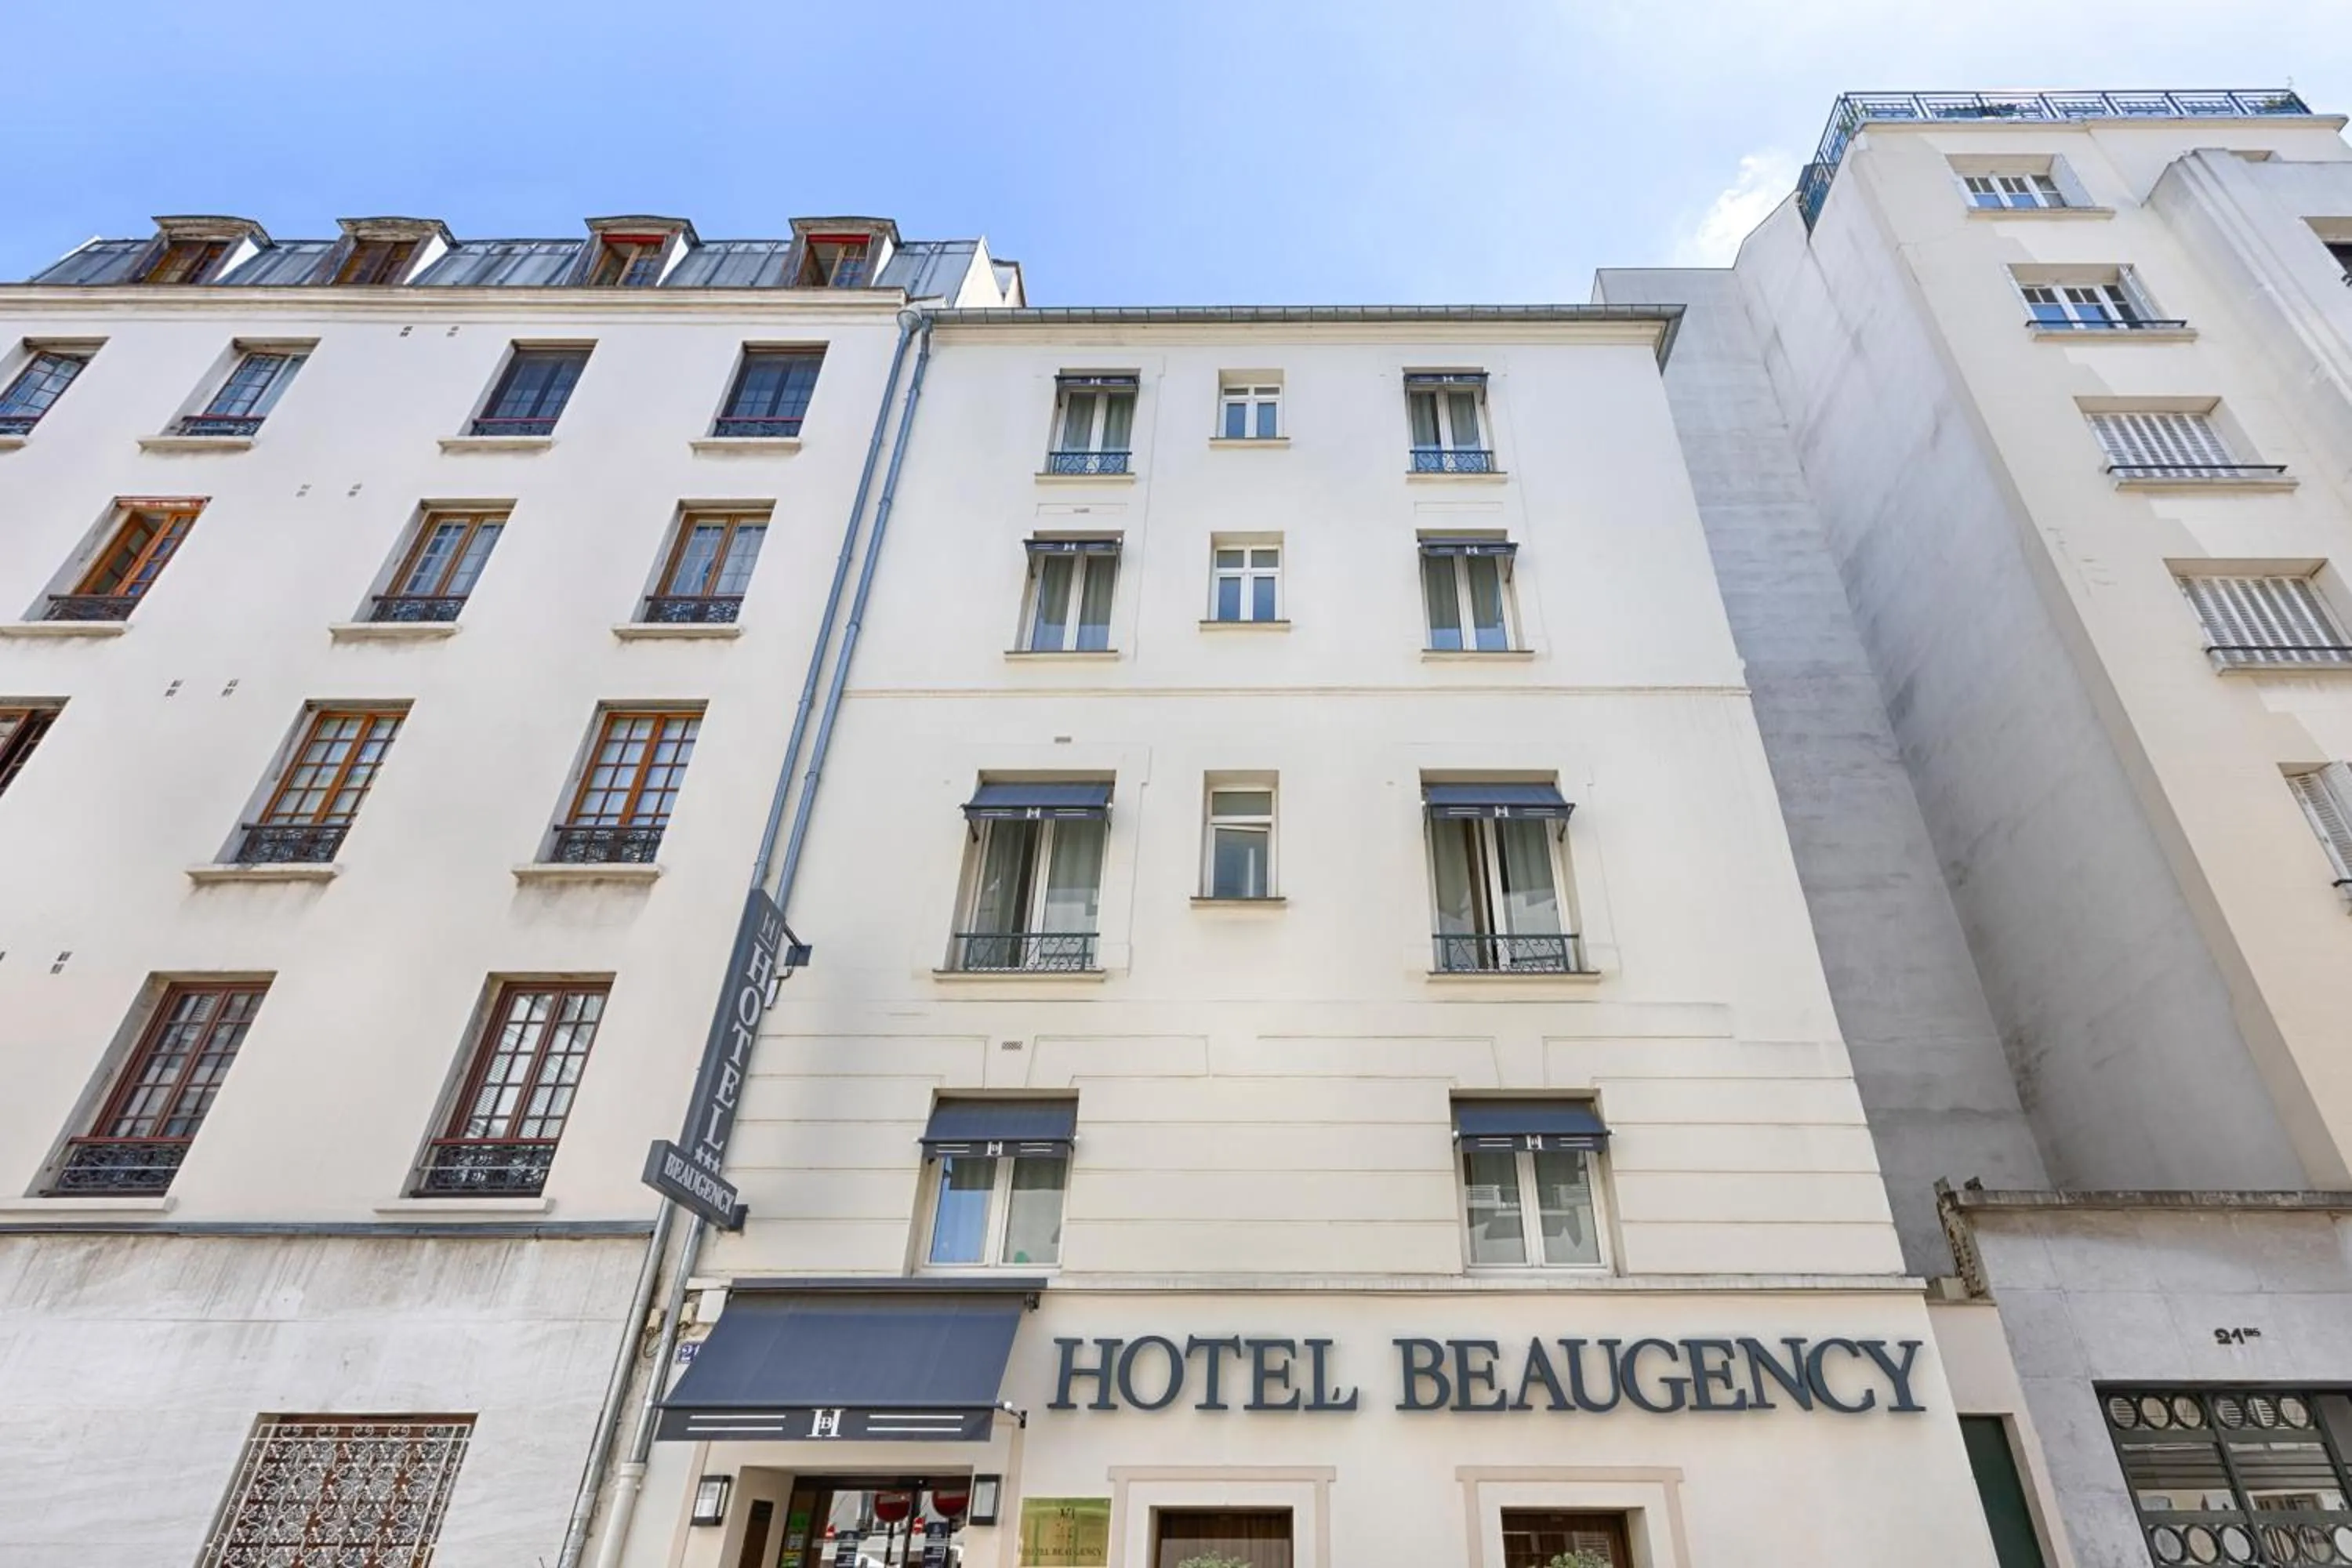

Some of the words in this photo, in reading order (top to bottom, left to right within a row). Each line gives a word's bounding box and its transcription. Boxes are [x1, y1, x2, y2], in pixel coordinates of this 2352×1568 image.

[702, 942, 772, 1150] HOTEL
[664, 1152, 735, 1215] BEAUGENCY
[1045, 1335, 1358, 1412] HOTEL
[1392, 1336, 1926, 1413] BEAUGENCY
